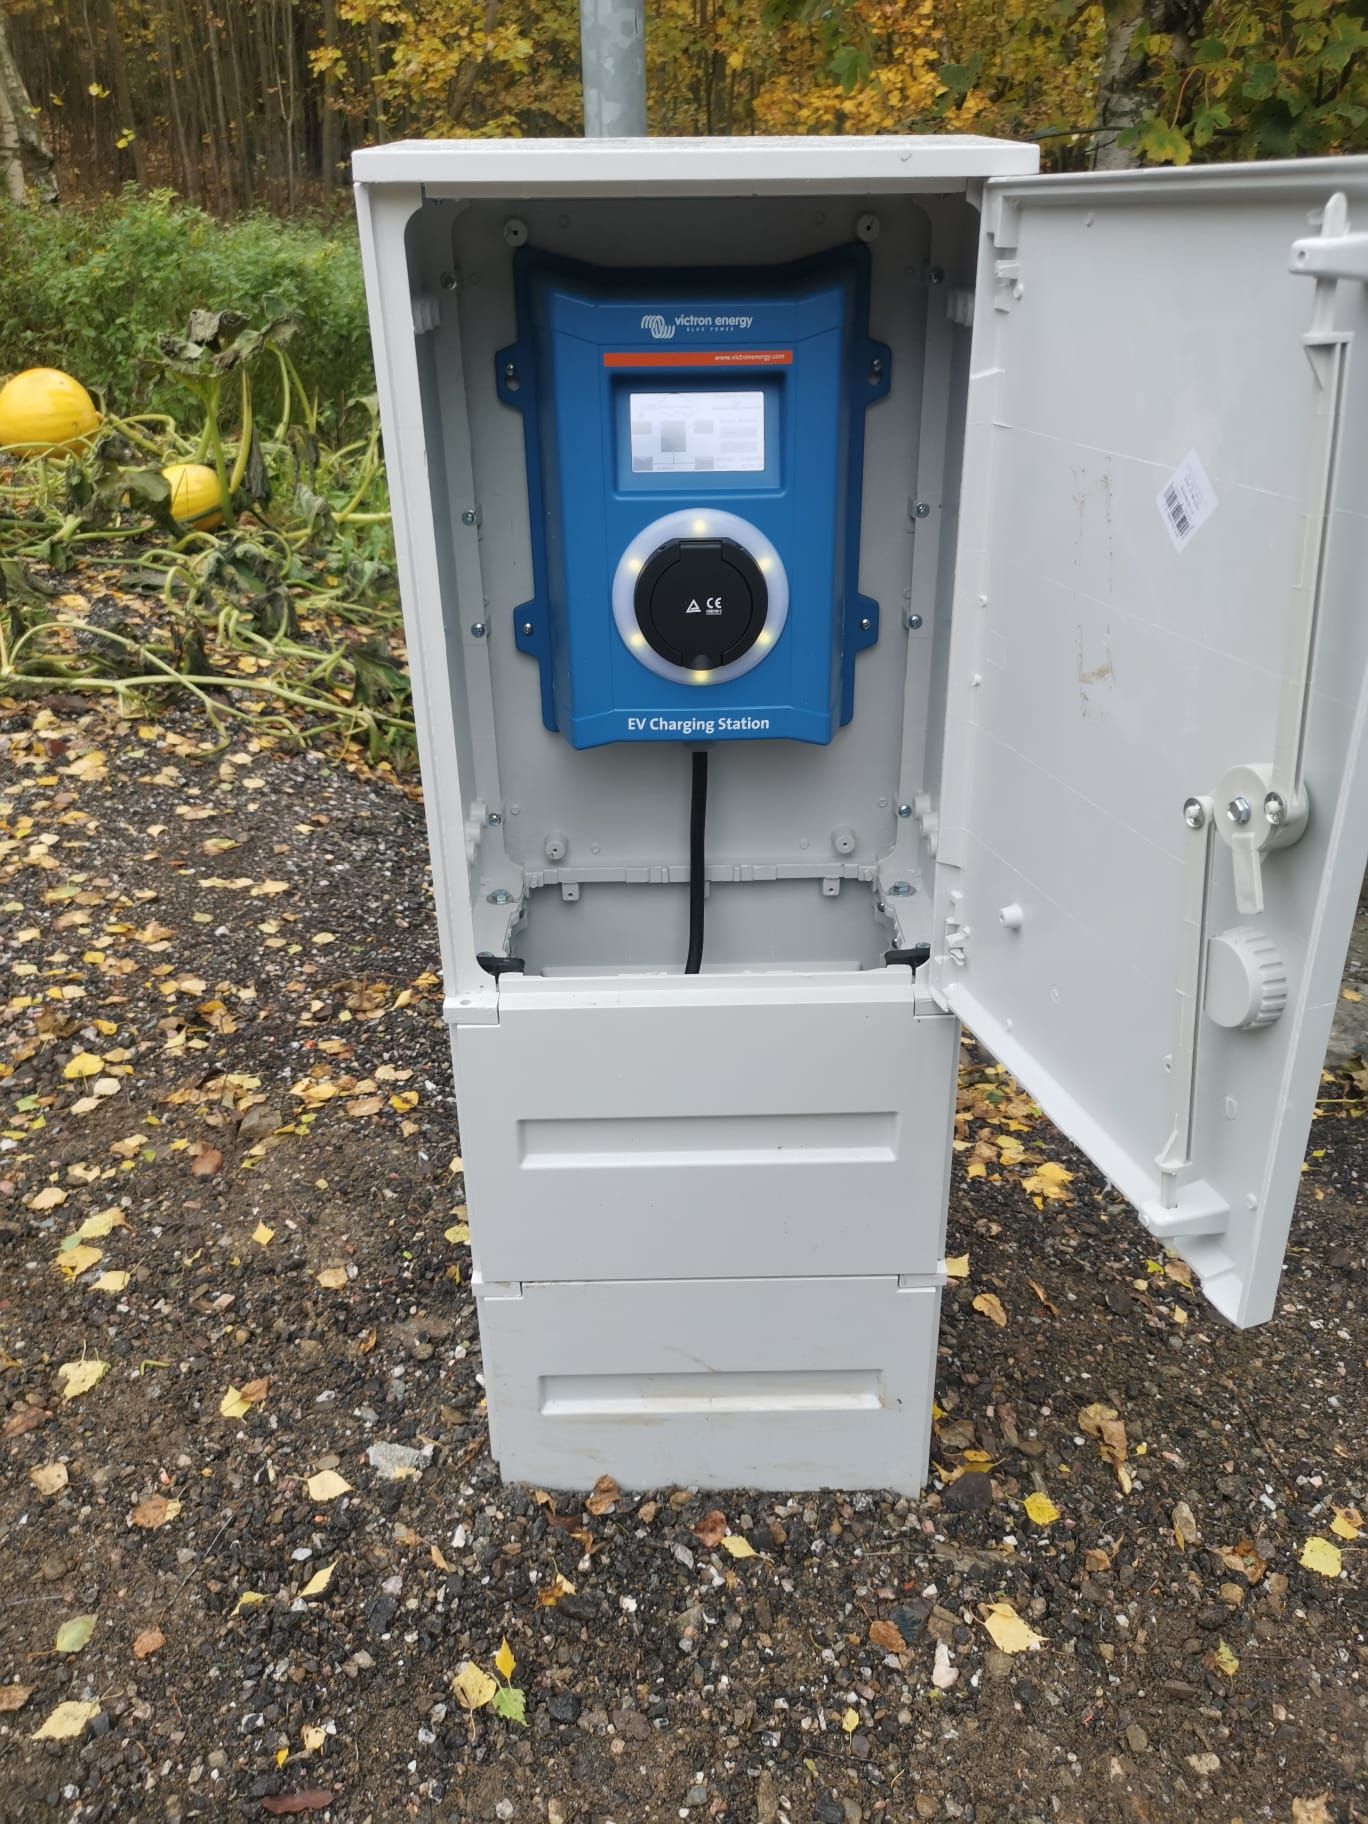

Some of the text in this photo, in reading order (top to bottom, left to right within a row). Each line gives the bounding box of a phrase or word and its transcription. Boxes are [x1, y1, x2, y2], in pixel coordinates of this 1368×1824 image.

[675, 314, 753, 328] victron energy
[714, 353, 785, 362] www.victronenergy.com
[706, 596, 722, 609] CE
[627, 716, 770, 735] EV Charging Station
